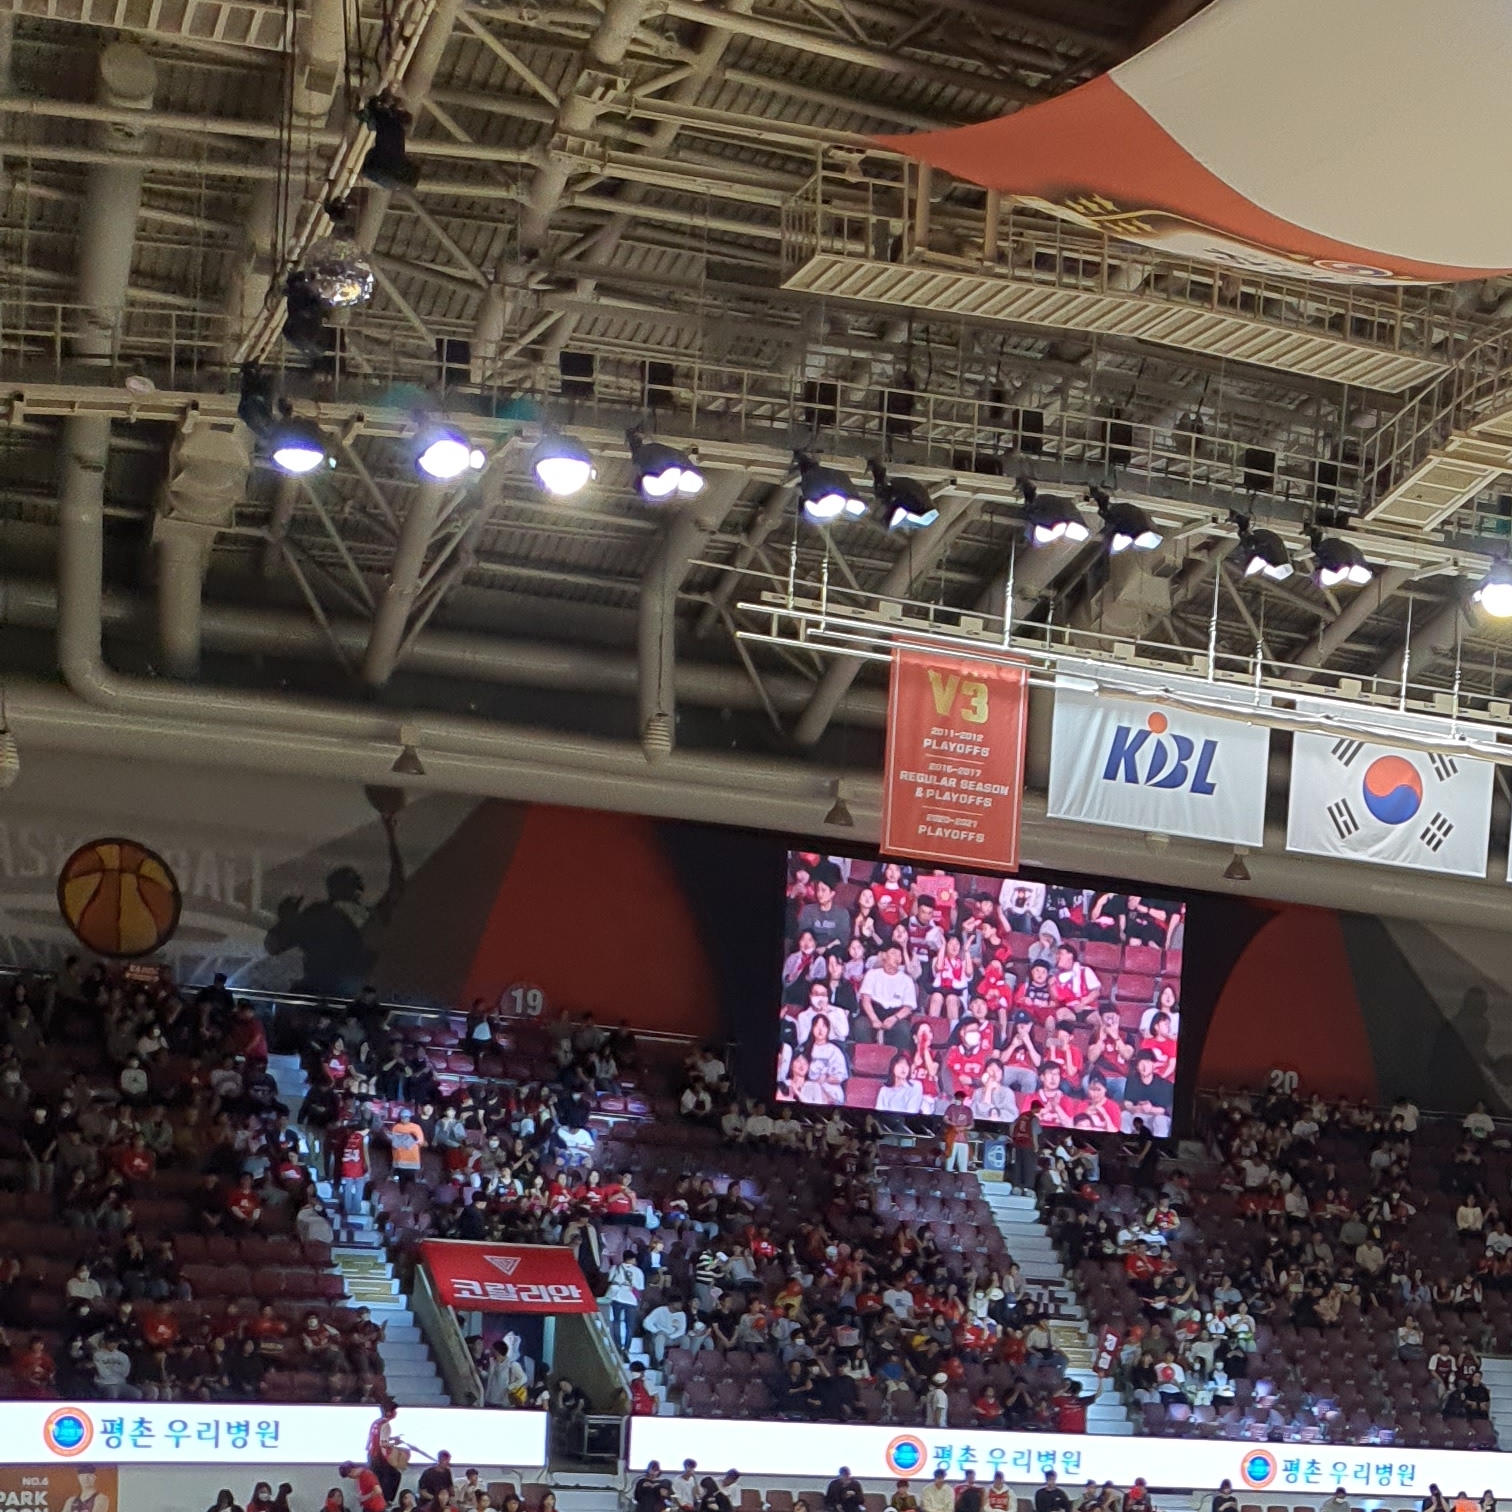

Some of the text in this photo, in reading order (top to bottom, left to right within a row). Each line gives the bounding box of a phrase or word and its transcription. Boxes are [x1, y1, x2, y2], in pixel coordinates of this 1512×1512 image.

[927, 669, 989, 724] V3
[923, 738, 990, 757] PLAYOFFS
[931, 727, 984, 742] 2011-2012
[1103, 711, 1218, 796] KBL
[900, 770, 1009, 796] REGULAR SEASON
[926, 788, 992, 808] PLAYOFFS
[918, 824, 985, 843] PLAYOFFS
[511, 987, 543, 1016] 19
[450, 1278, 584, 1303] 코랄리안
[100, 1417, 280, 1449] 평촌 우리병원
[932, 1444, 1082, 1475] 평촌 우리병원
[1281, 1457, 1416, 1487] 평촌 우리병원
